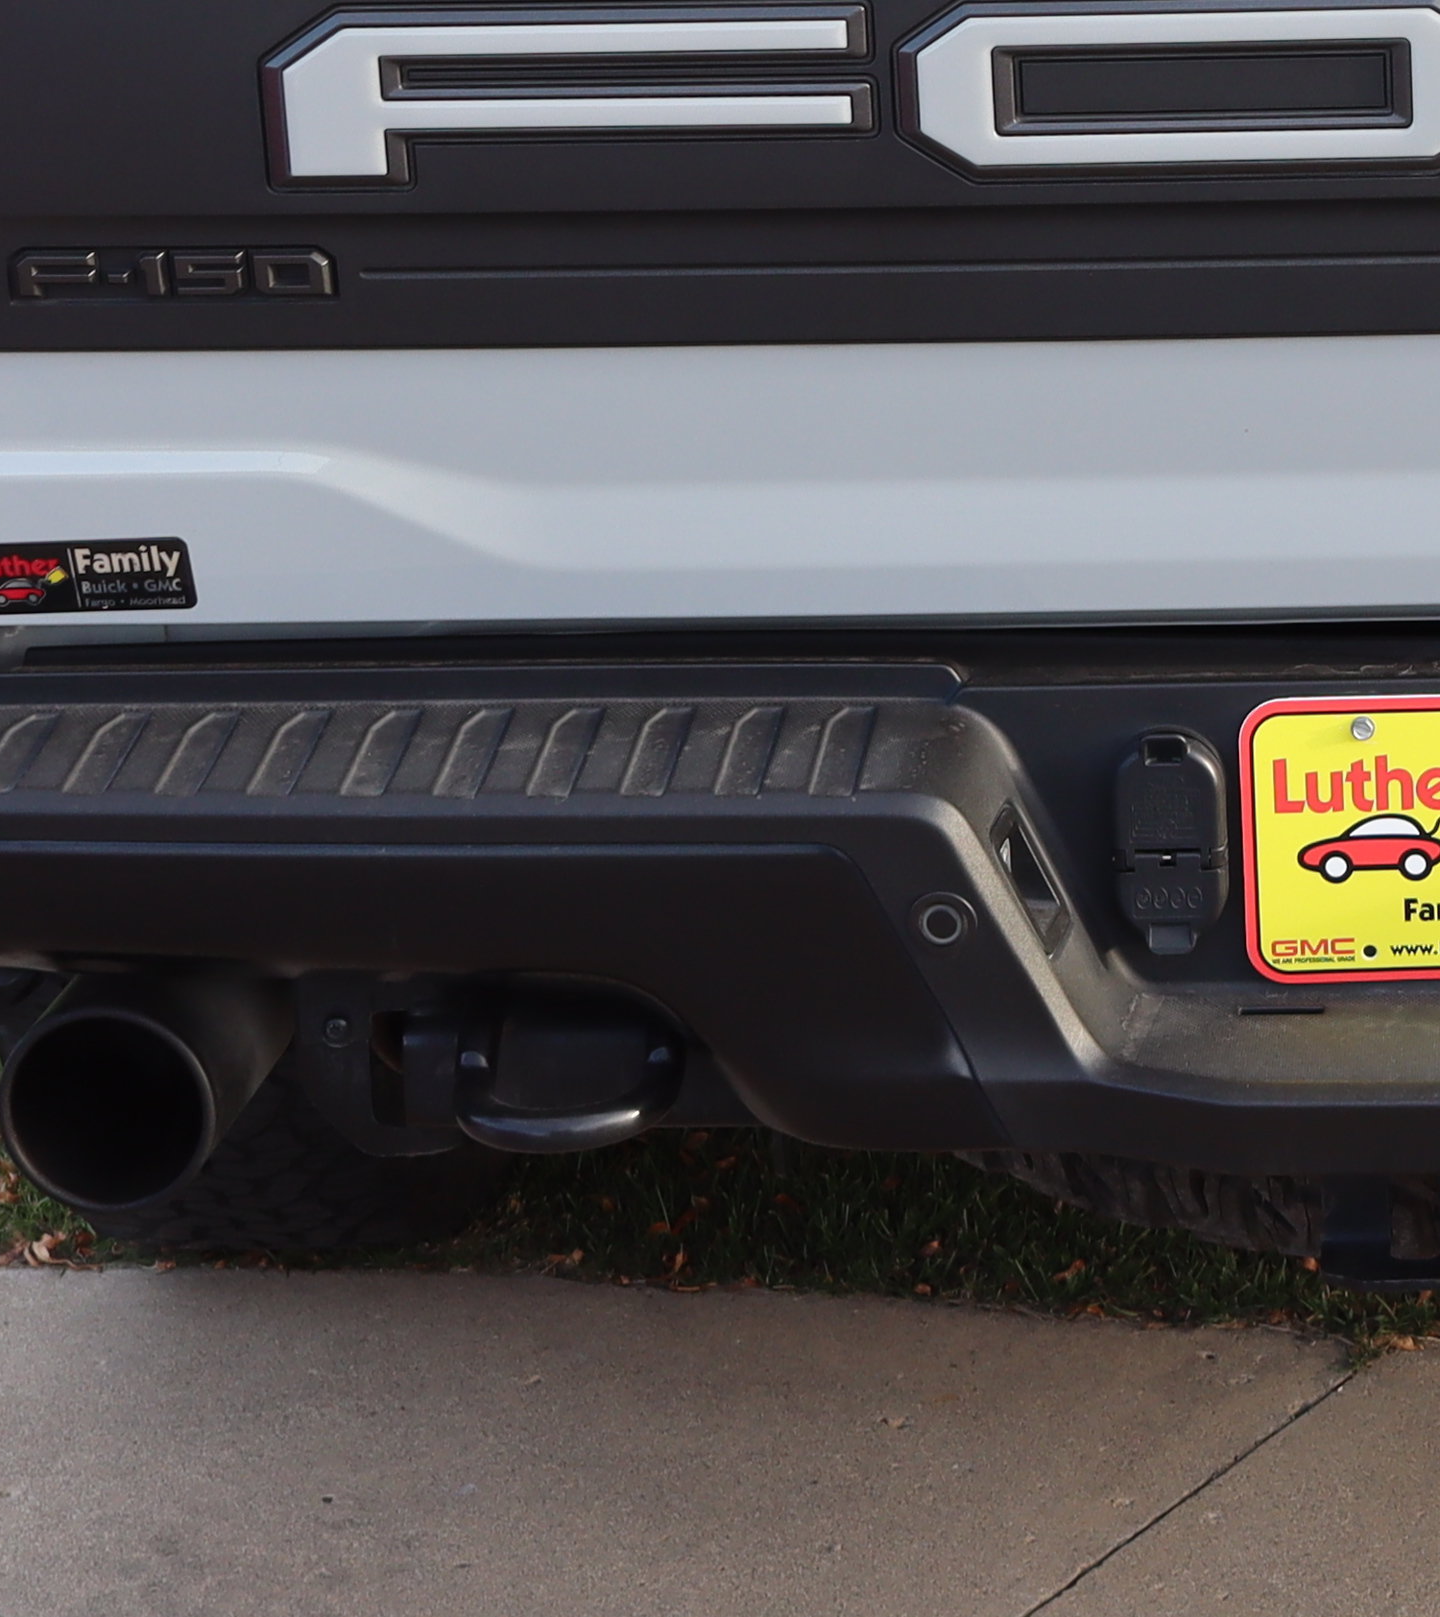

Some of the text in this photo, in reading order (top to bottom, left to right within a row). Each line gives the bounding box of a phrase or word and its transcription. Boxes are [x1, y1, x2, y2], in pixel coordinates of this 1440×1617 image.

[10, 246, 339, 298] F-150
[74, 544, 180, 577] Family
[81, 579, 182, 594] Buick GMC
[1271, 938, 1356, 957] GMC
